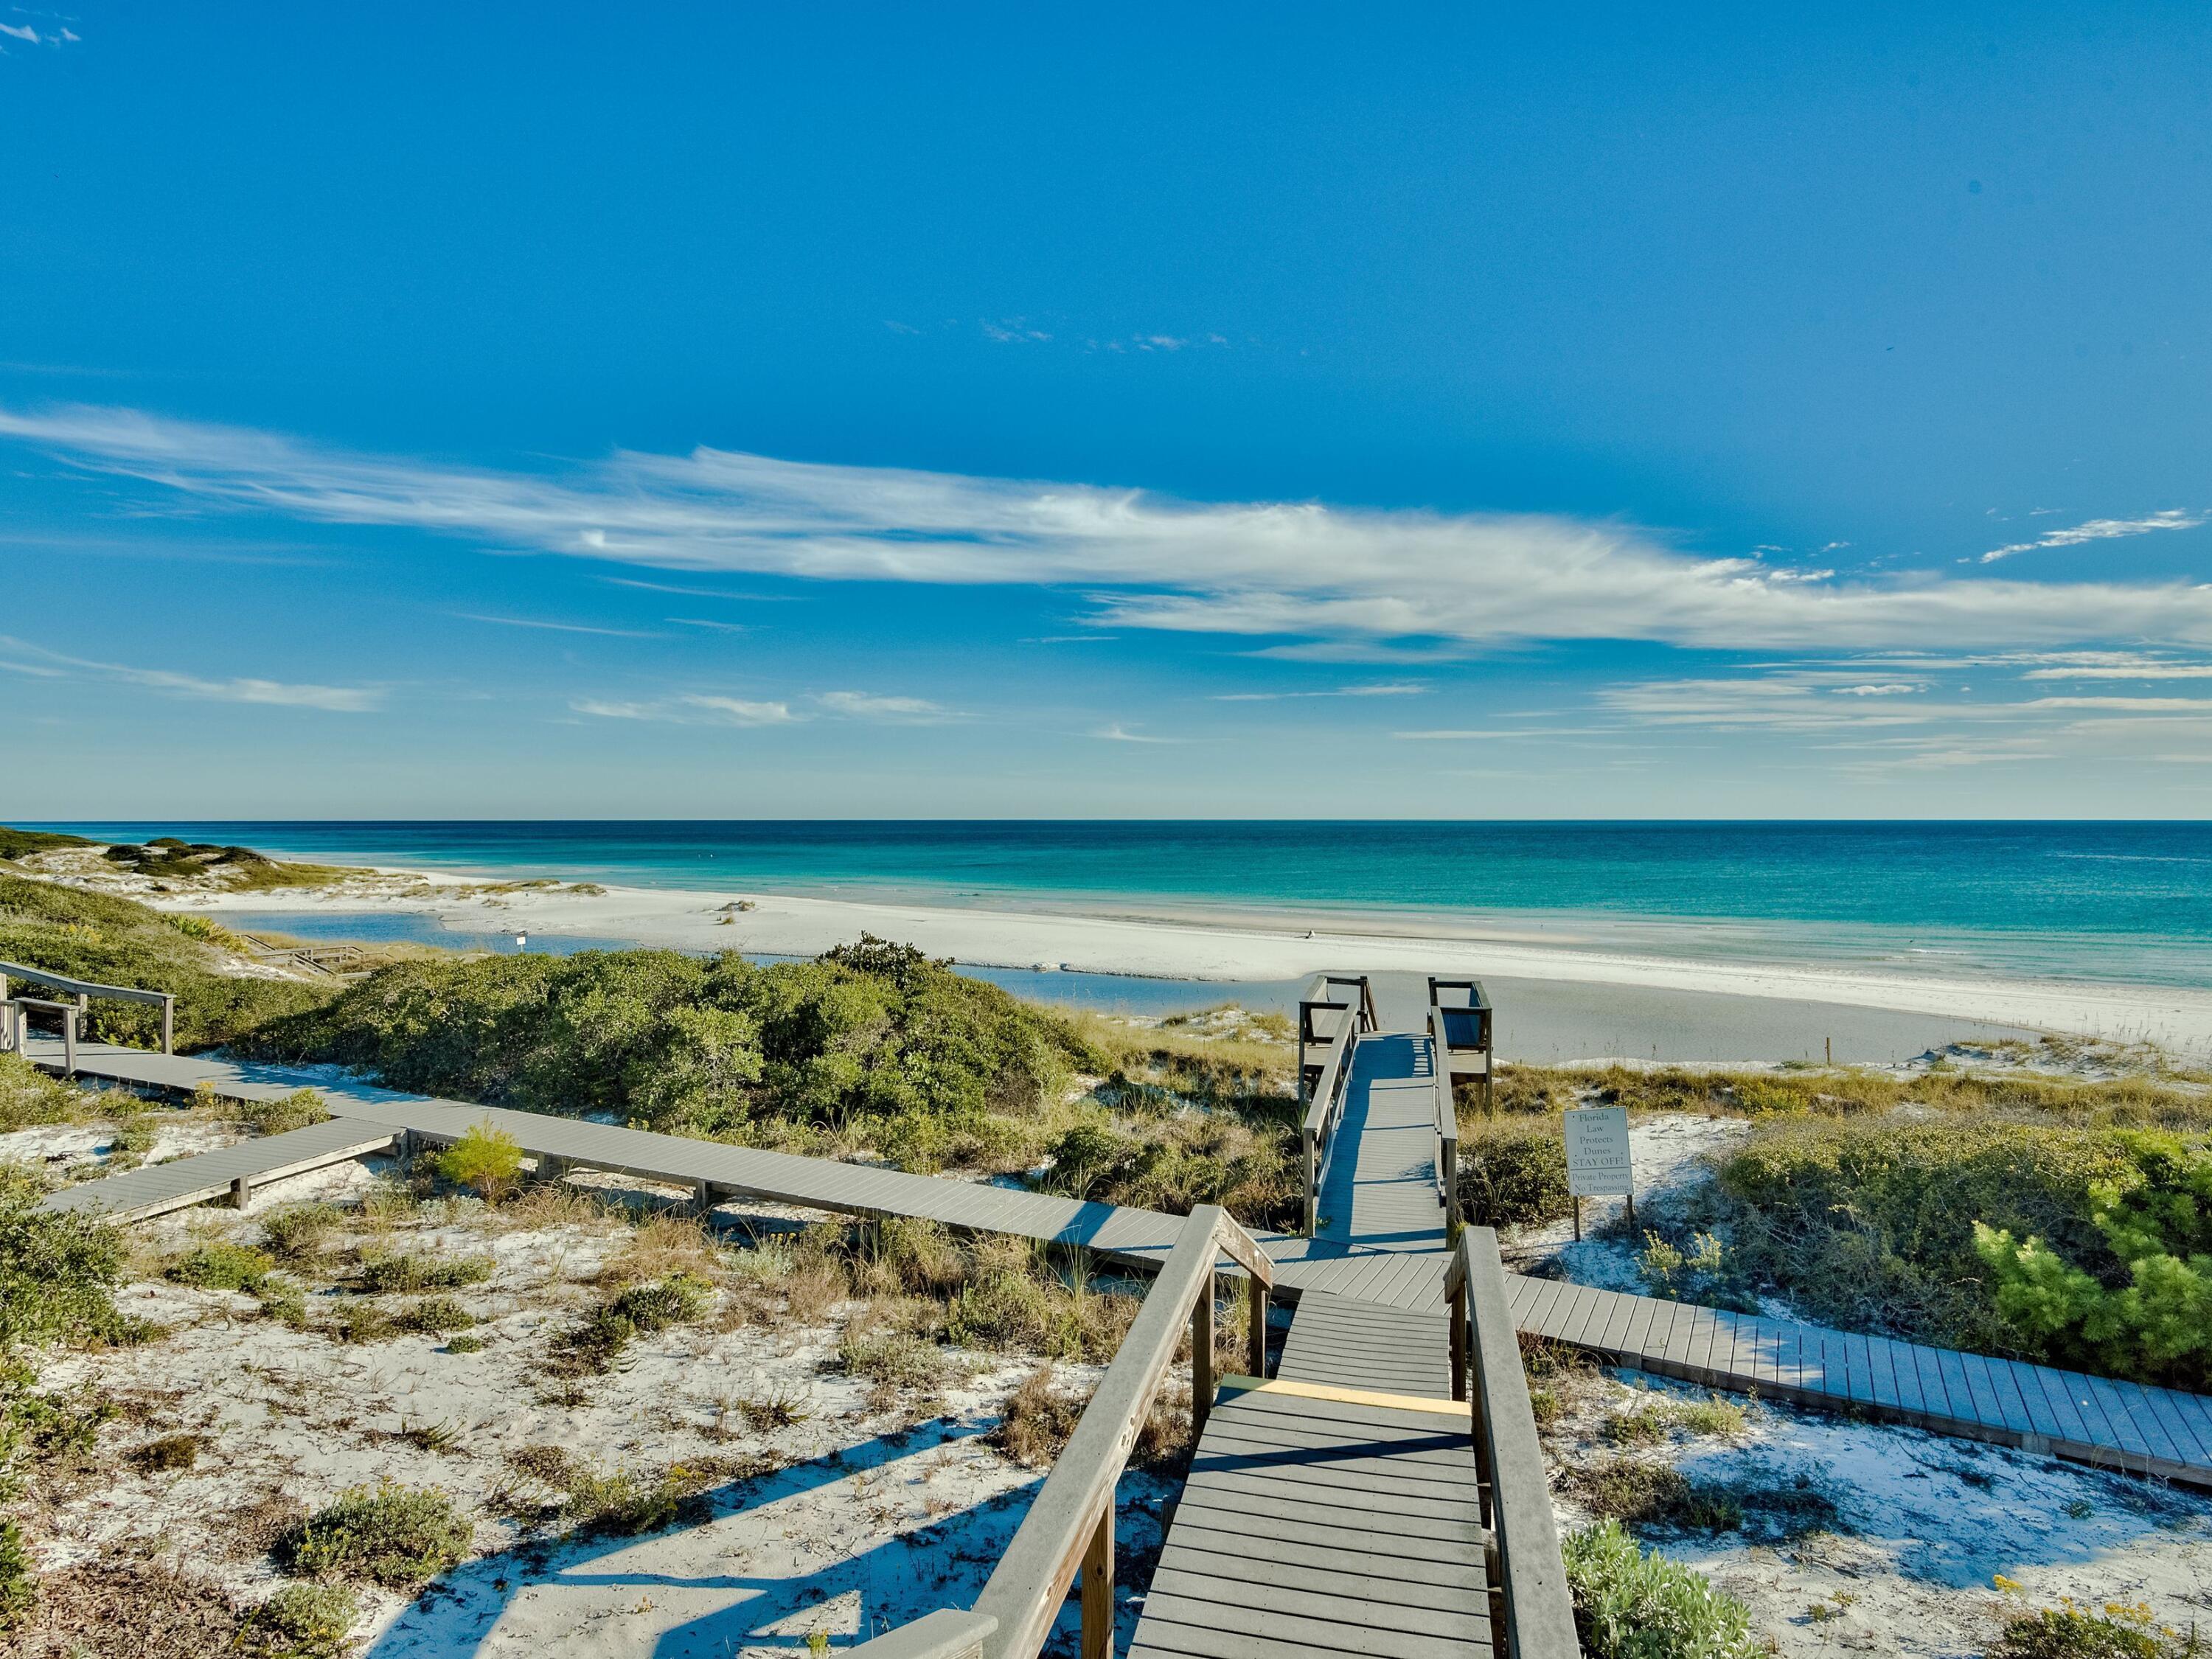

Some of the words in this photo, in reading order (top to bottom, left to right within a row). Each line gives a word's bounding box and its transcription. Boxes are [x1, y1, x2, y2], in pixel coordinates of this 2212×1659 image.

[1579, 1113, 1609, 1121] Florida
[1579, 1136, 1613, 1144] Protects
[1573, 1158, 1598, 1166] STAY
[1601, 1156, 1624, 1165] OFF!
[1572, 1173, 1596, 1181] Private
[1599, 1172, 1629, 1180] Property
